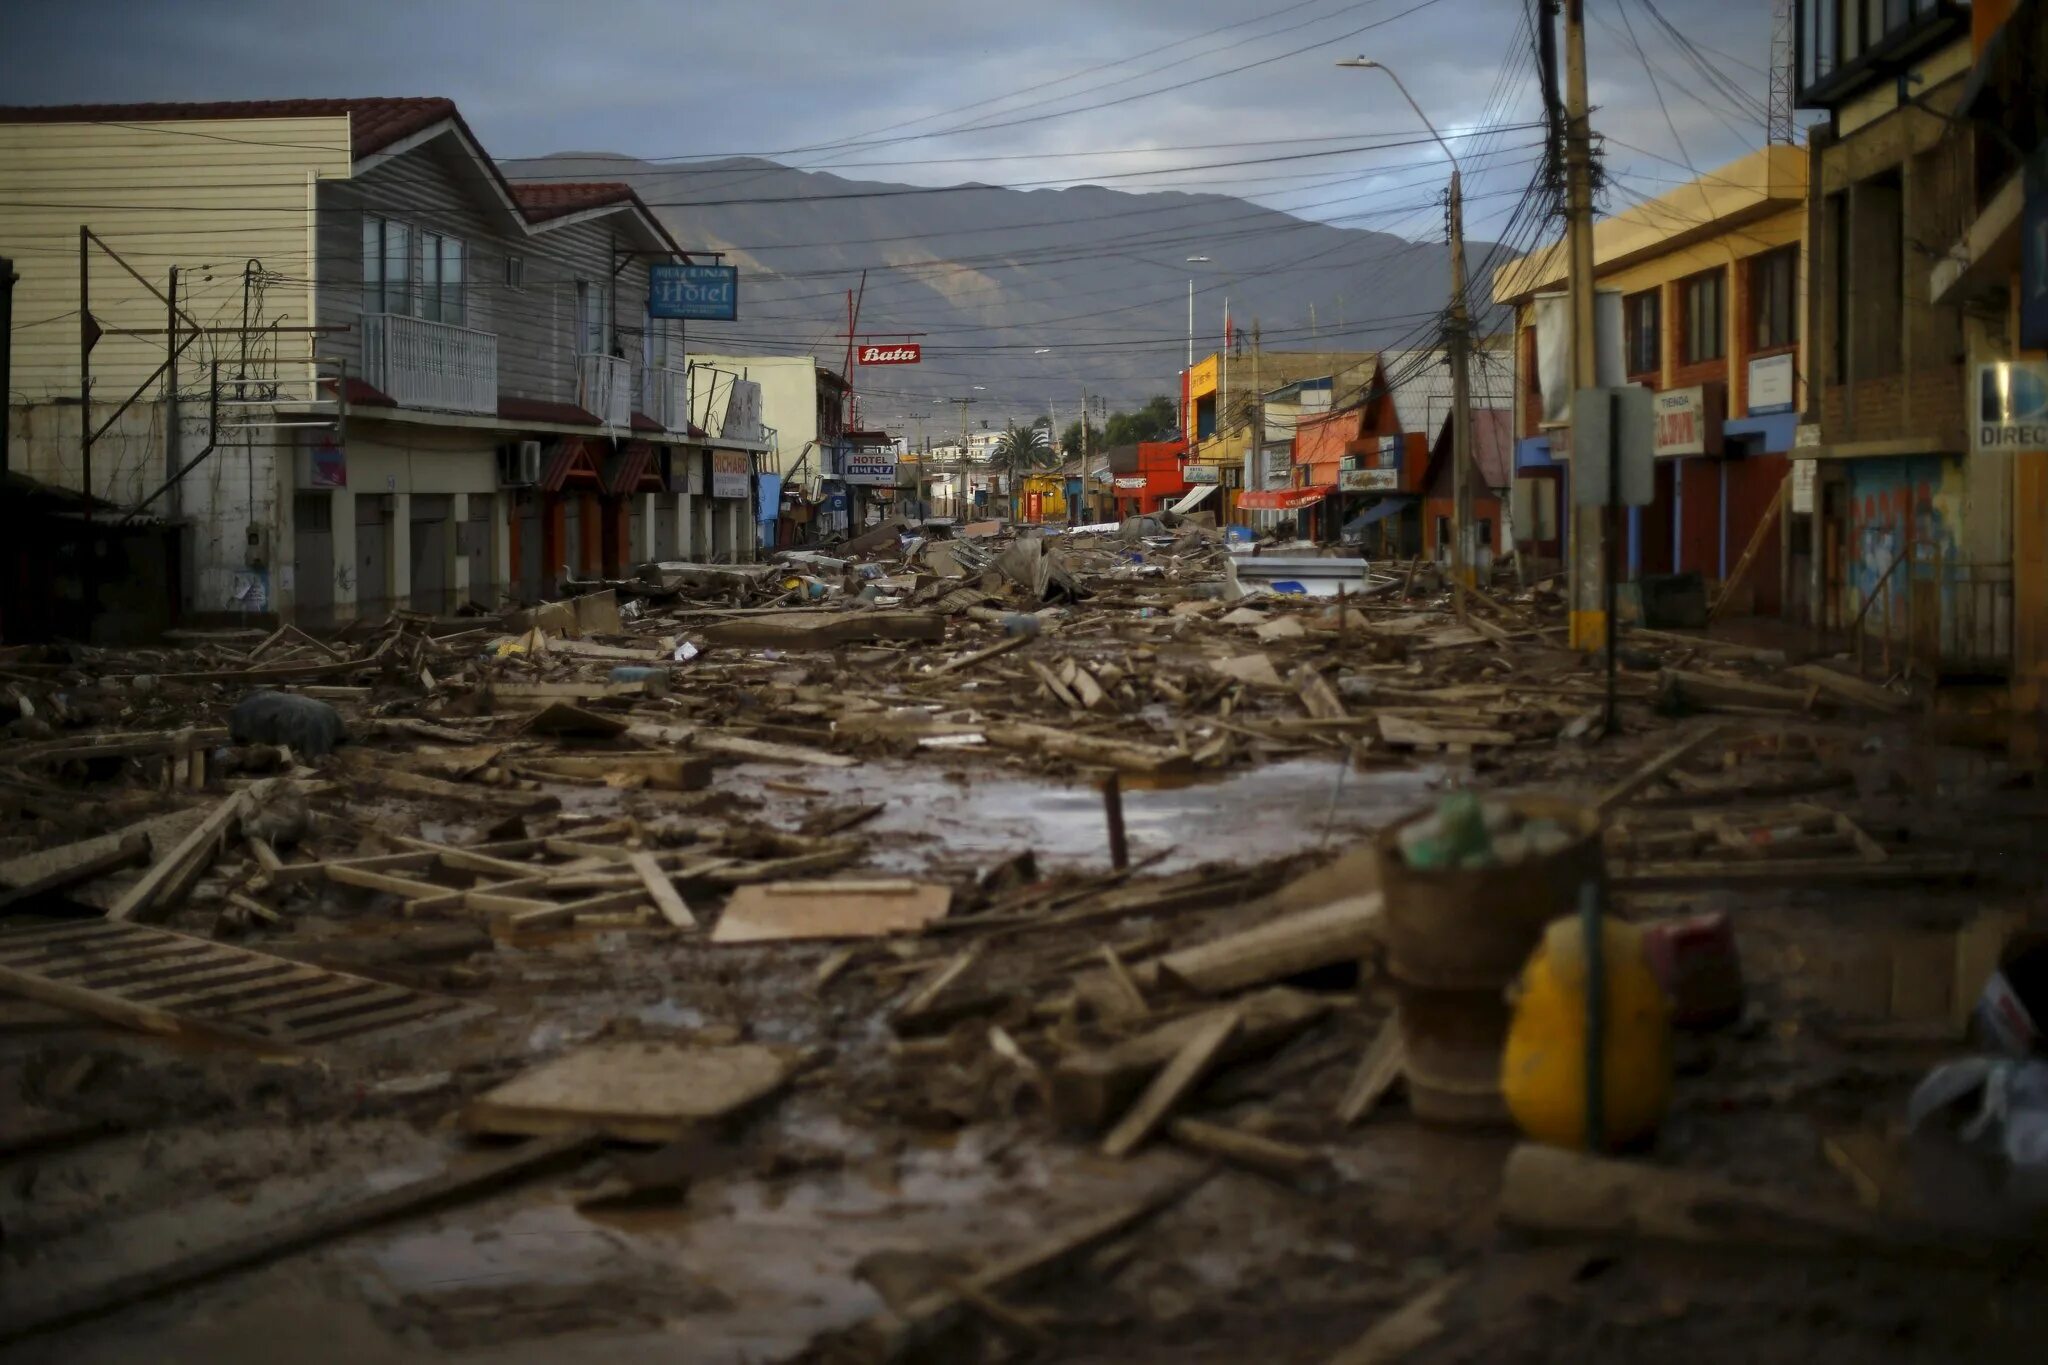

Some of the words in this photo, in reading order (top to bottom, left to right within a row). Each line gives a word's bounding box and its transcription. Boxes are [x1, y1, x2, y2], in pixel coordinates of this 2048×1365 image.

[656, 280, 730, 302] Hotel
[862, 347, 917, 362] Bata
[1660, 394, 1689, 409] TIENDA
[714, 454, 748, 475] RICHARD
[853, 456, 888, 465] HOTEL
[850, 466, 892, 475] JIMENEZ
